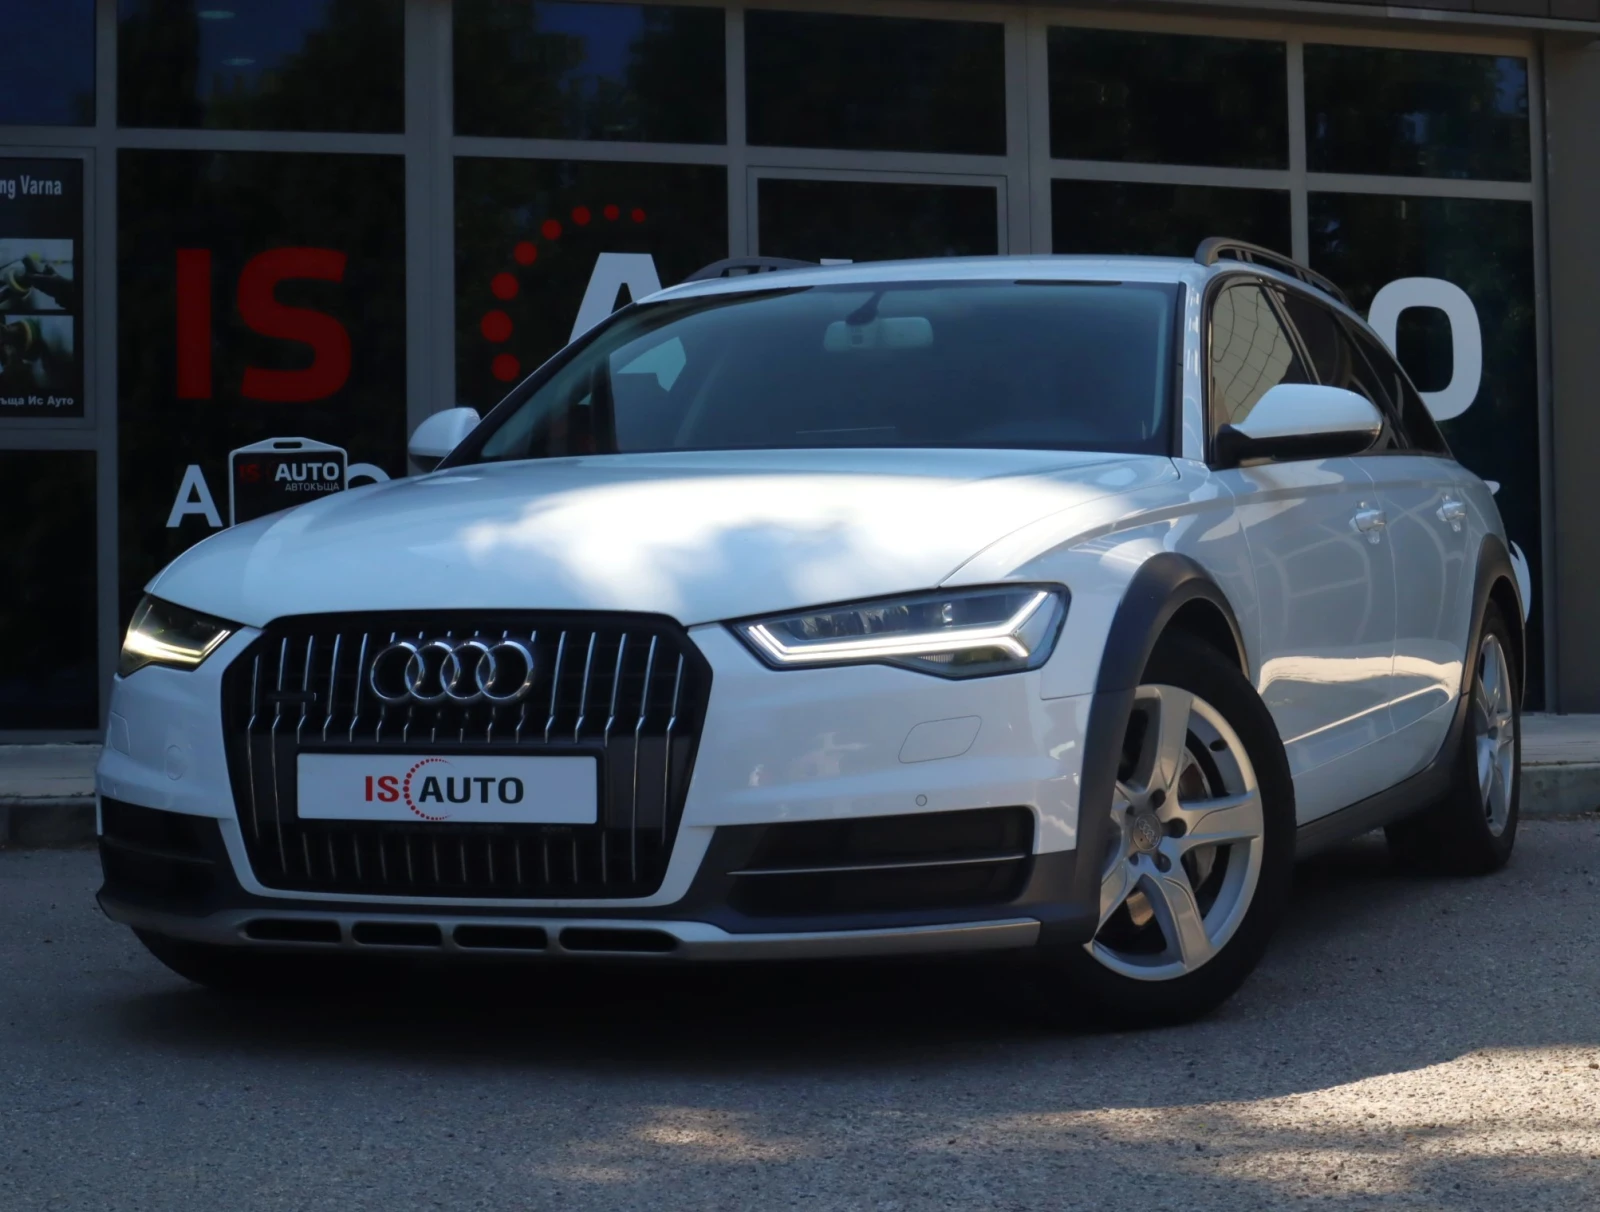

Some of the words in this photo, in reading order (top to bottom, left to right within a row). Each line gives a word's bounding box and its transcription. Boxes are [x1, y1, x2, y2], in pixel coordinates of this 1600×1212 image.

[20, 174, 63, 195] Varna
[175, 246, 352, 403] IS
[28, 395, 44, 406] Ис
[47, 395, 74, 408] Ауто
[274, 462, 340, 482] AUTO
[284, 482, 340, 492] АВТОКЪЩА
[365, 775, 400, 803] IS
[418, 776, 524, 804] AUTO
